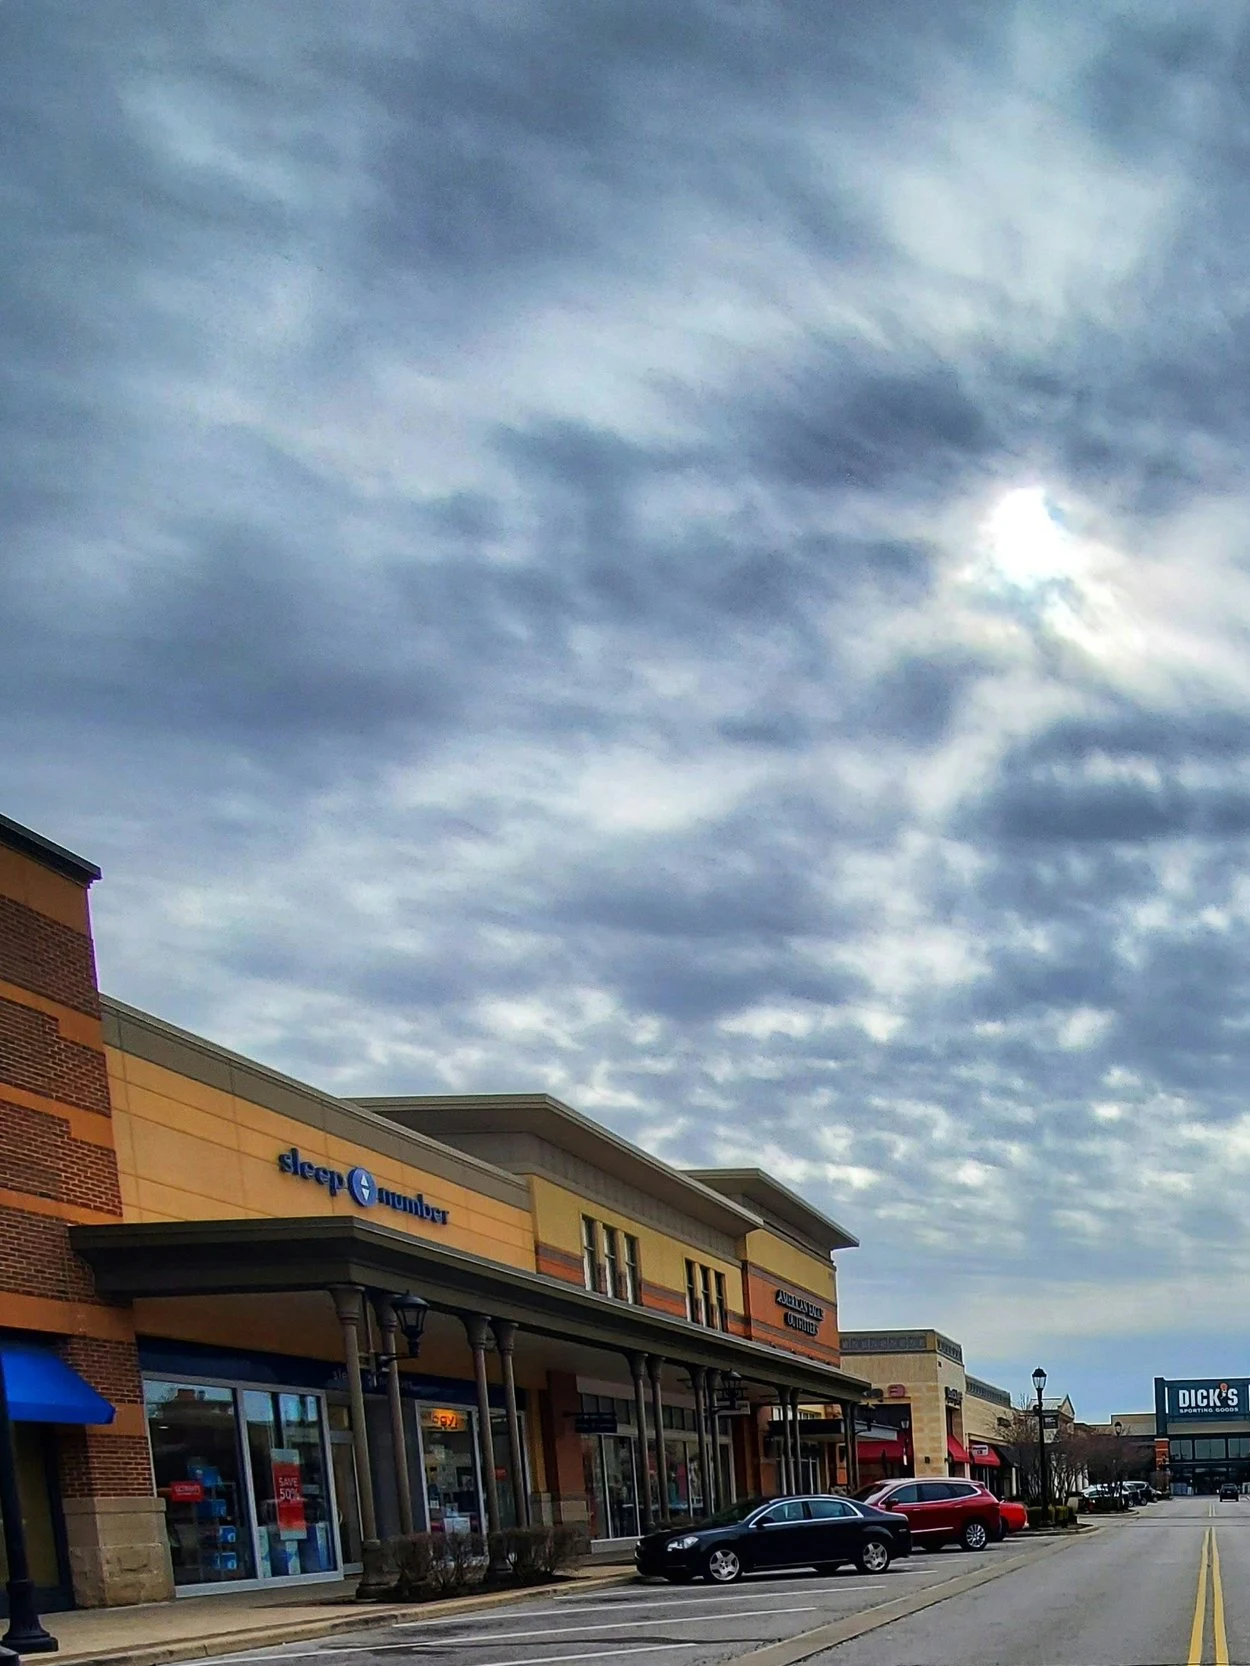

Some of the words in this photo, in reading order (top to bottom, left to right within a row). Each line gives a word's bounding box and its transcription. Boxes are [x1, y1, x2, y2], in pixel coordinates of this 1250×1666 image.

[278, 1148, 343, 1196] sleep
[378, 1187, 449, 1225] number
[1178, 1388, 1238, 1407] DICK'S
[279, 1477, 298, 1487] SAVE
